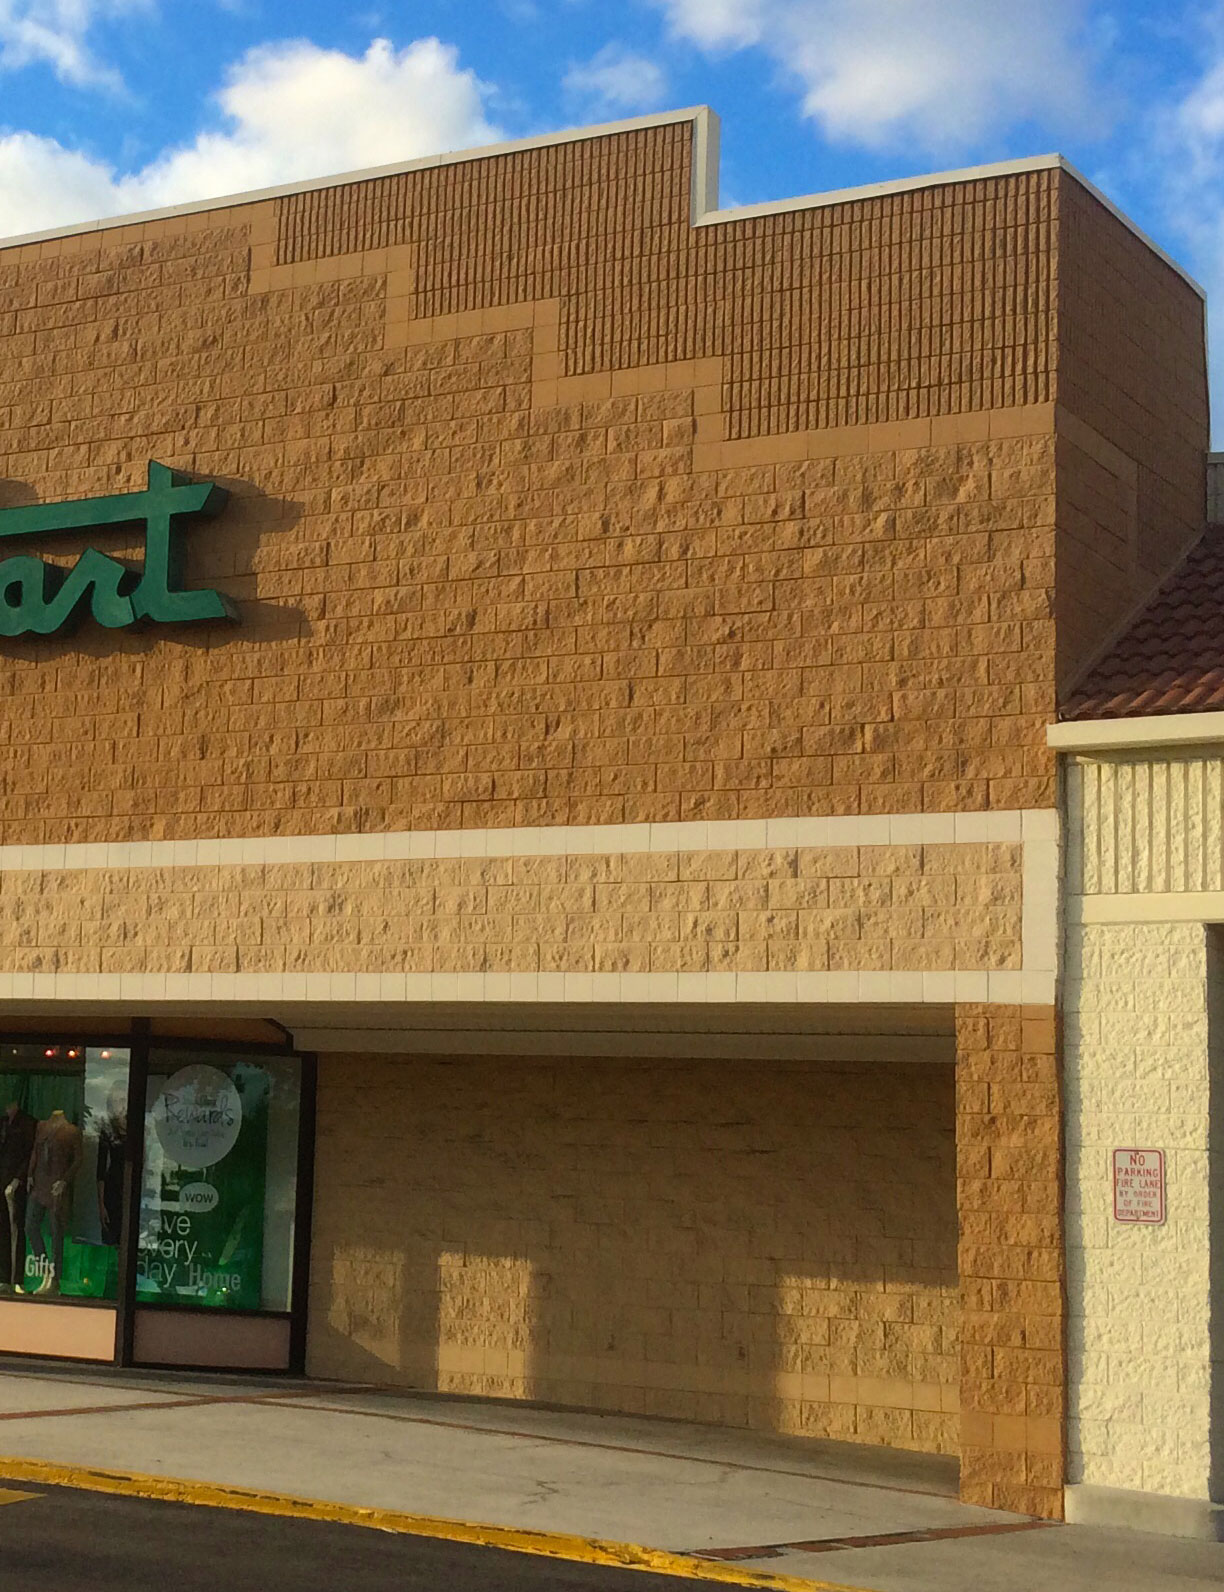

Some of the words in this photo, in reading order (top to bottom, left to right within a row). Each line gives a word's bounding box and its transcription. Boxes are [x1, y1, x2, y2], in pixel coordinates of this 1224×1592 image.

[1129, 1154, 1145, 1166] NO
[1117, 1167, 1159, 1178] PARKING
[1116, 1178, 1134, 1188] FIRE
[1139, 1180, 1160, 1189] LANE
[1119, 1190, 1128, 1198] BY
[1133, 1190, 1157, 1199] ORDER
[1137, 1200, 1153, 1208] FIRE
[1117, 1209, 1159, 1218] DEPARTMENT
[26, 1254, 55, 1278] Gifts
[137, 1255, 178, 1288] day
[189, 1262, 241, 1291] Home
